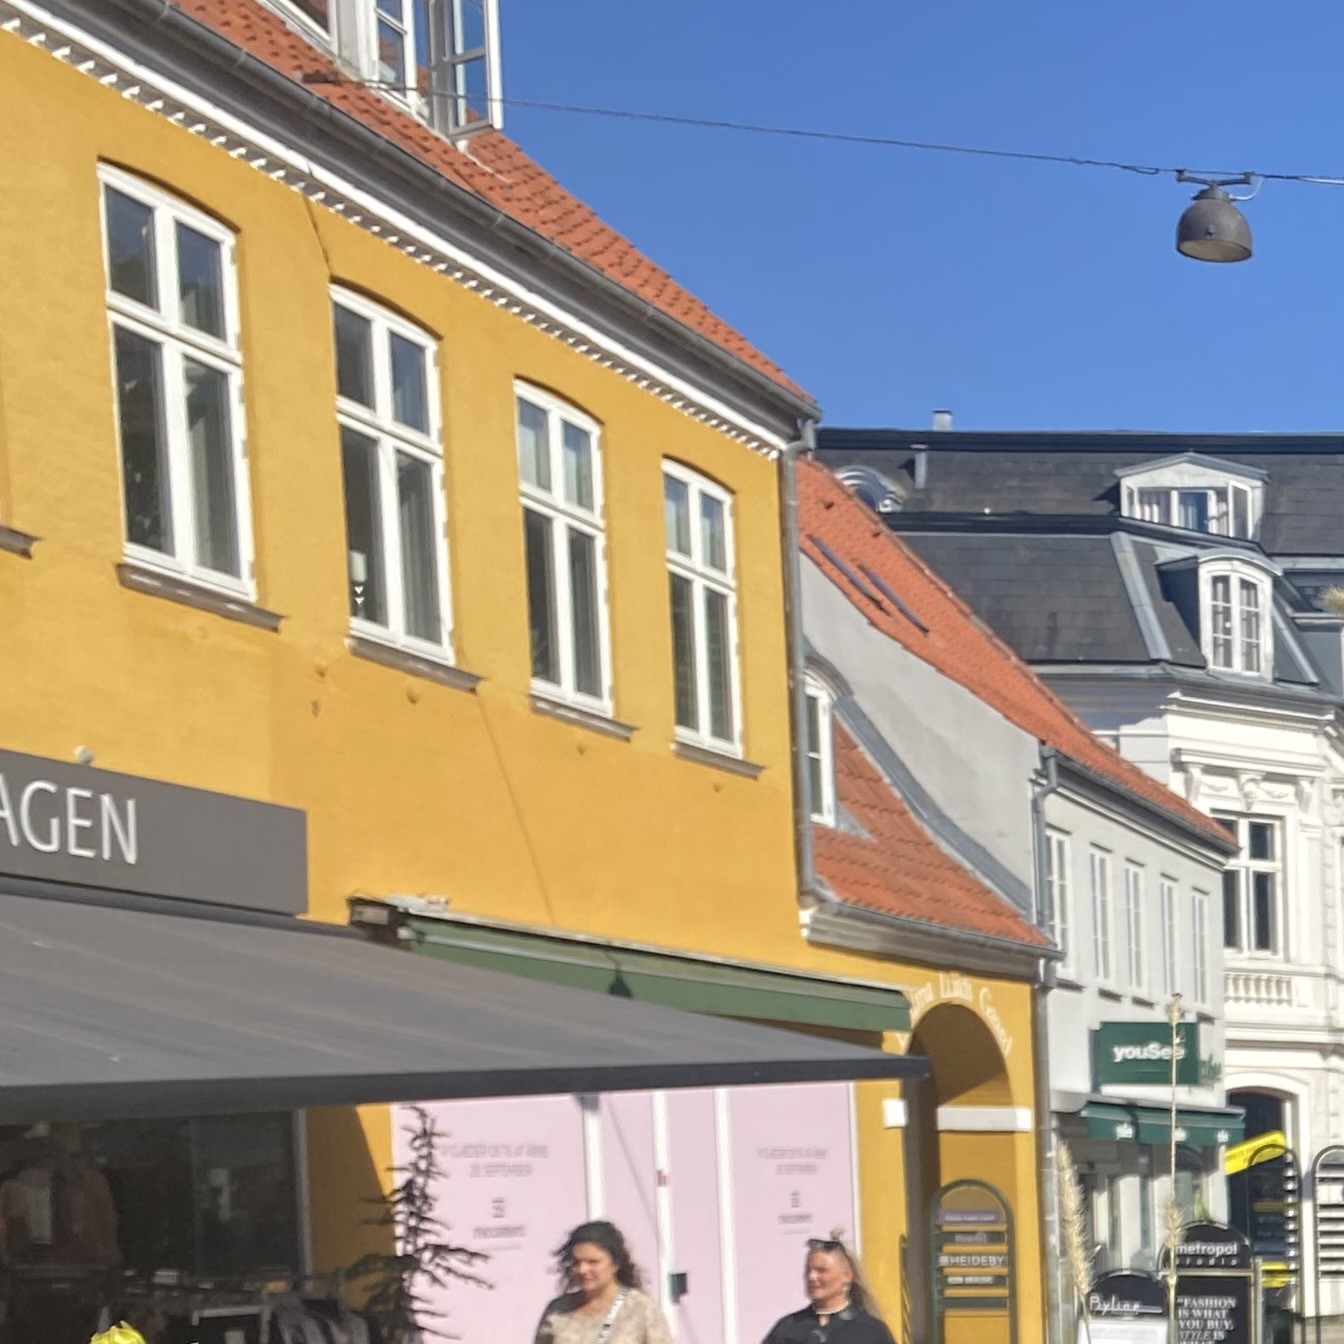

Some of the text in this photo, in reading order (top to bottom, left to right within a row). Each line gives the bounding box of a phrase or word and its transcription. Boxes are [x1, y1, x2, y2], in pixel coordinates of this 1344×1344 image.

[1175, 1242, 1238, 1258] metropol
[950, 1255, 1004, 1266] HEIDEBY
[1178, 1309, 1227, 1319] IS WHAT
[1179, 1320, 1203, 1330] YOU
[1213, 1330, 1225, 1341] IS
